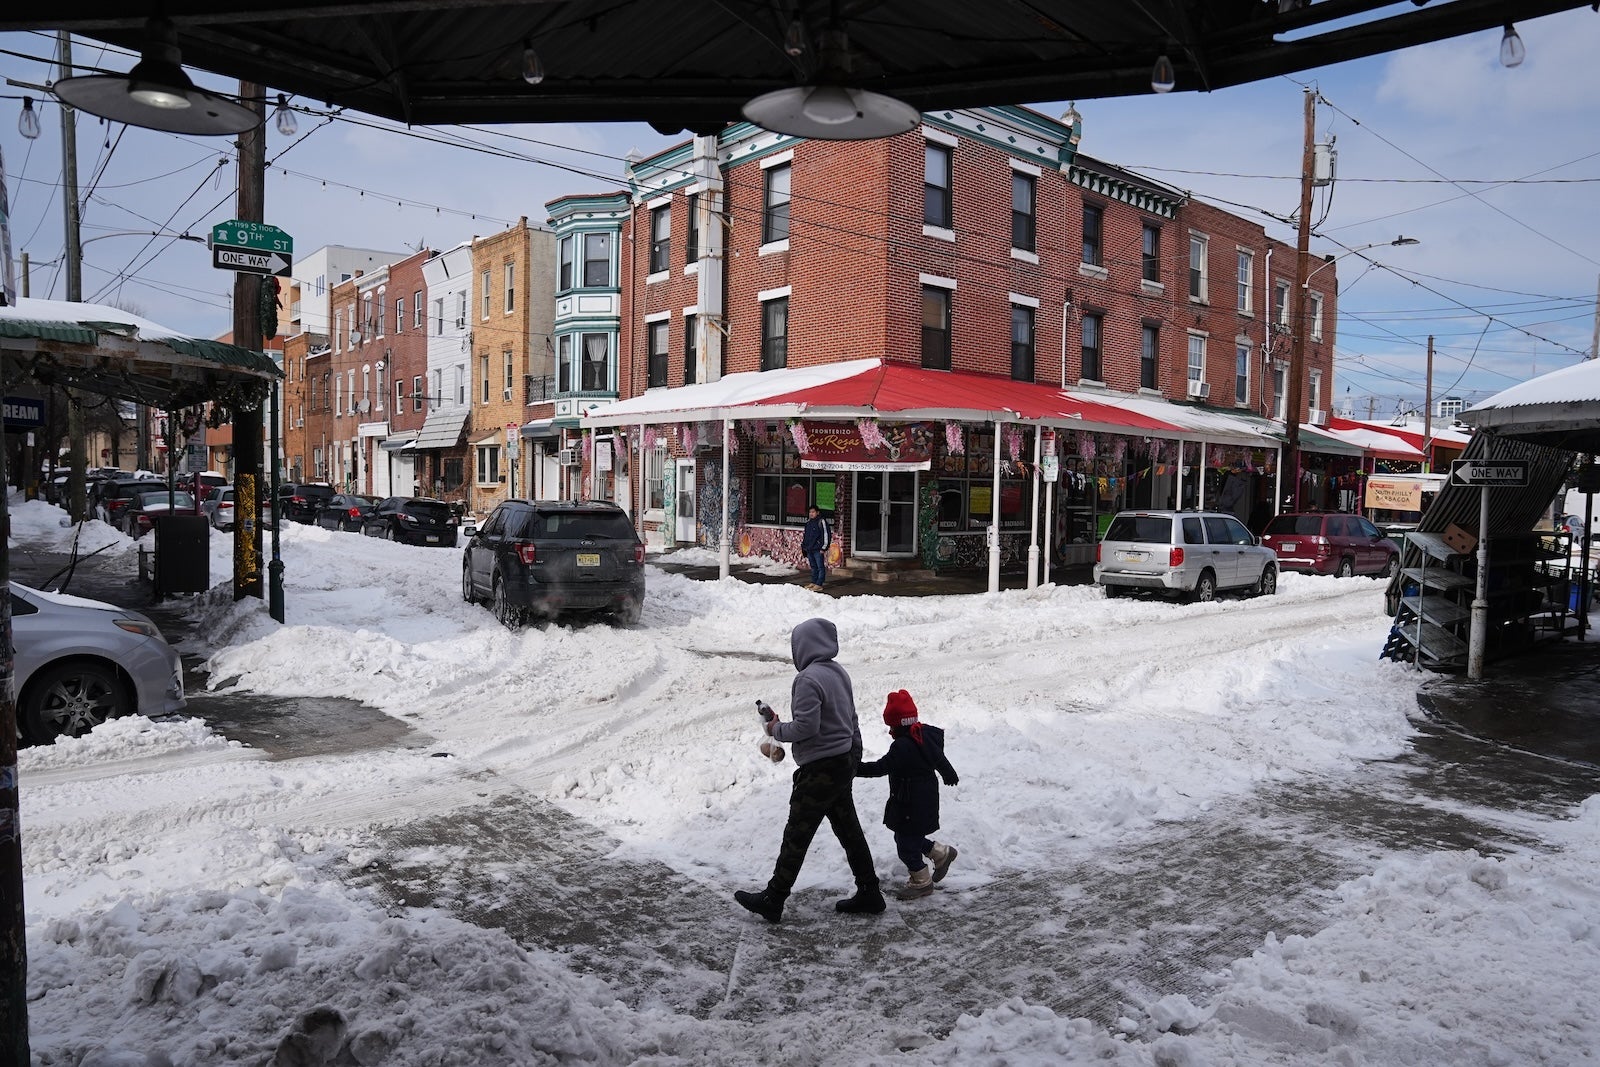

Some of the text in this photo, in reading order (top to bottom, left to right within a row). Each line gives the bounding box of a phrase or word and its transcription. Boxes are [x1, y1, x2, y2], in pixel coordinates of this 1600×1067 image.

[251, 223, 257, 231] S
[259, 225, 274, 233] 1100
[273, 239, 289, 251] ST
[222, 252, 270, 267] ONE WAY
[824, 434, 861, 450] Rosas
[1471, 468, 1520, 478] ONE WAY
